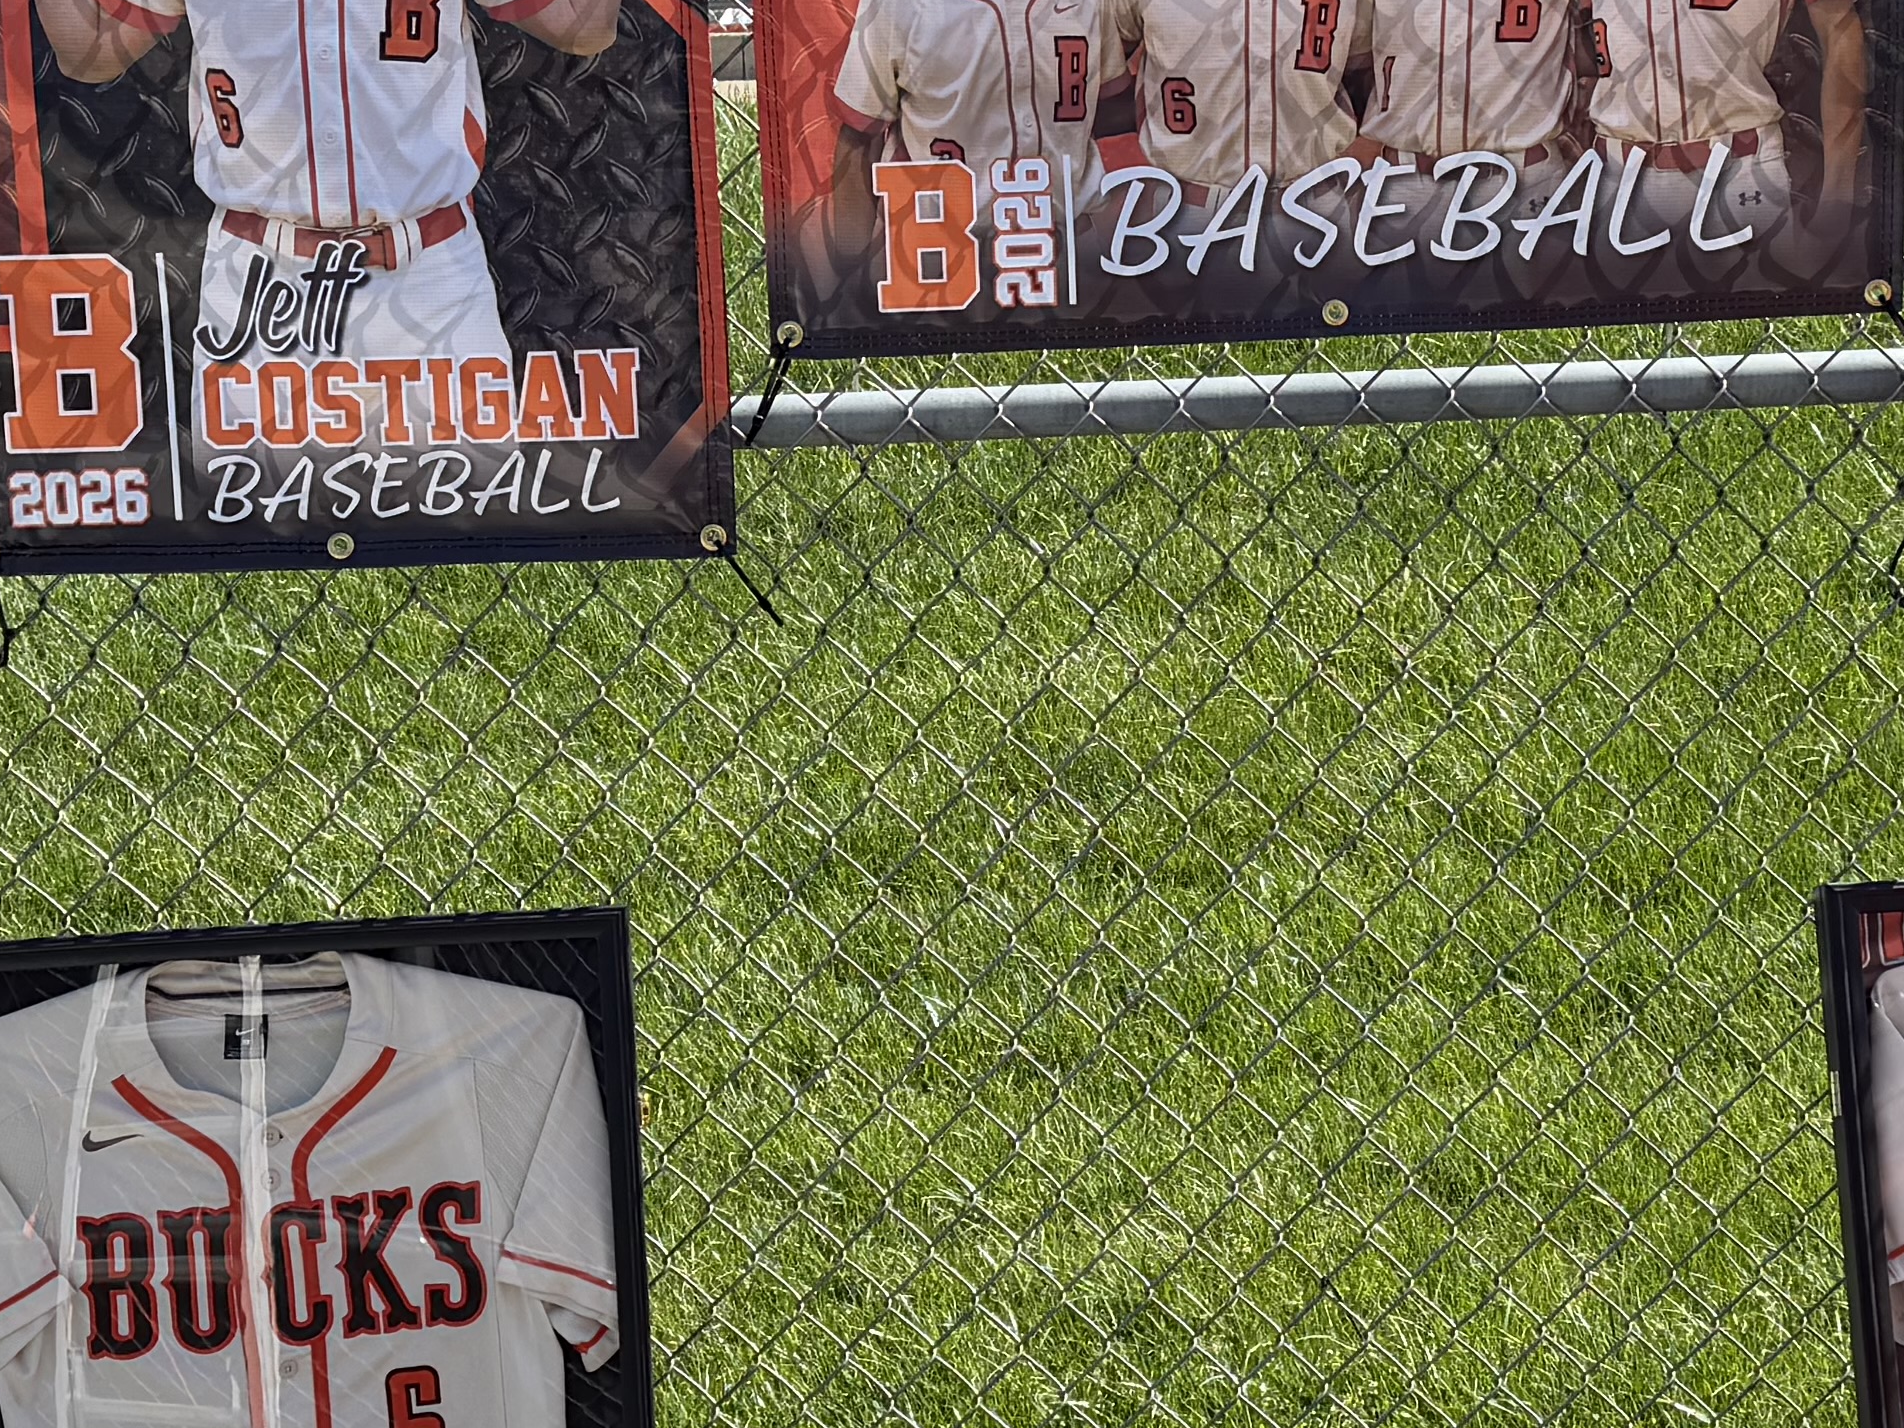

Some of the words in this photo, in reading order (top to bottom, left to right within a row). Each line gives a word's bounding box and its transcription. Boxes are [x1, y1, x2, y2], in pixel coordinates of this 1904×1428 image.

[205, 67, 245, 149] 6
[1053, 35, 1089, 123] B
[1161, 77, 1197, 135] 6
[872, 158, 981, 313] B
[989, 157, 1058, 308] 2026
[1099, 141, 1753, 276] BASEBALL
[201, 347, 640, 450] COSTIGAN
[8, 469, 150, 529] 2026
[205, 448, 621, 526] BASEBALL
[76, 1179, 488, 1361] BUCKS
